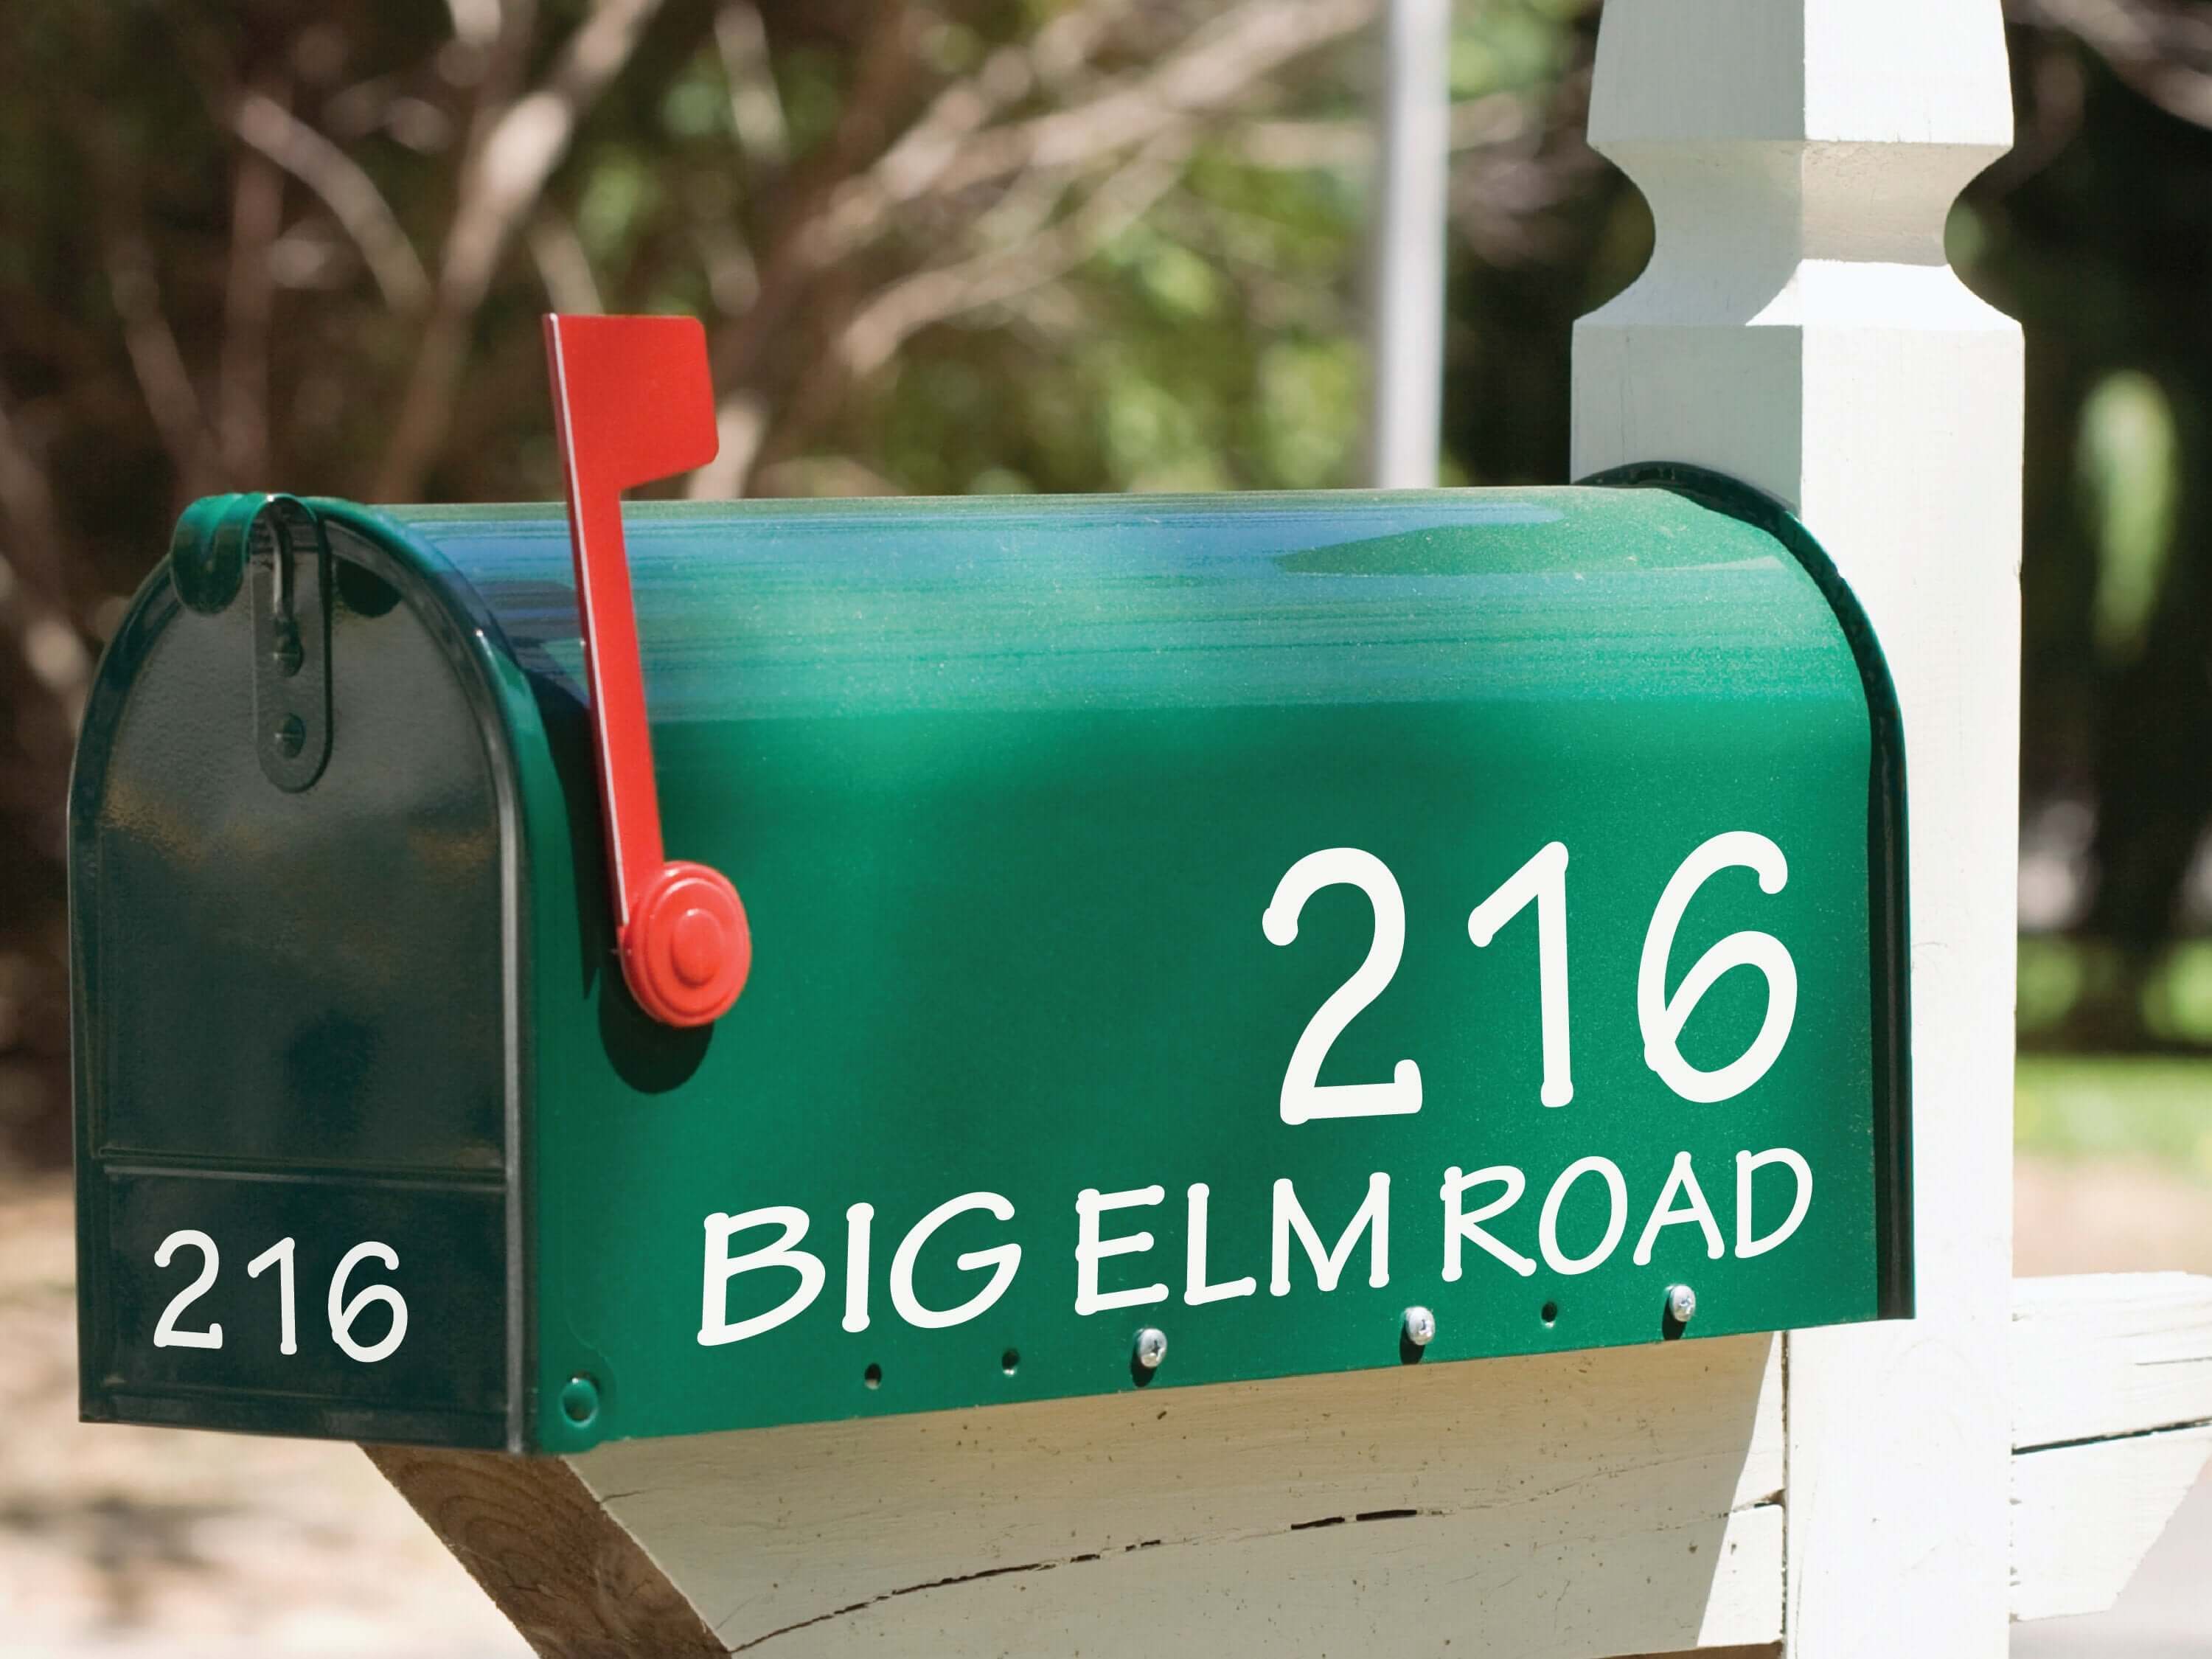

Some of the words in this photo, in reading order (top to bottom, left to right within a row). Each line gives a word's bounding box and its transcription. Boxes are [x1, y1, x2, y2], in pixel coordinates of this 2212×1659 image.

[1262, 830, 1798, 1125] 216
[153, 1229, 408, 1363] 216
[697, 1192, 1023, 1346] BIG
[1074, 1172, 1391, 1316] ELM
[1439, 1147, 1814, 1282] ROAD
